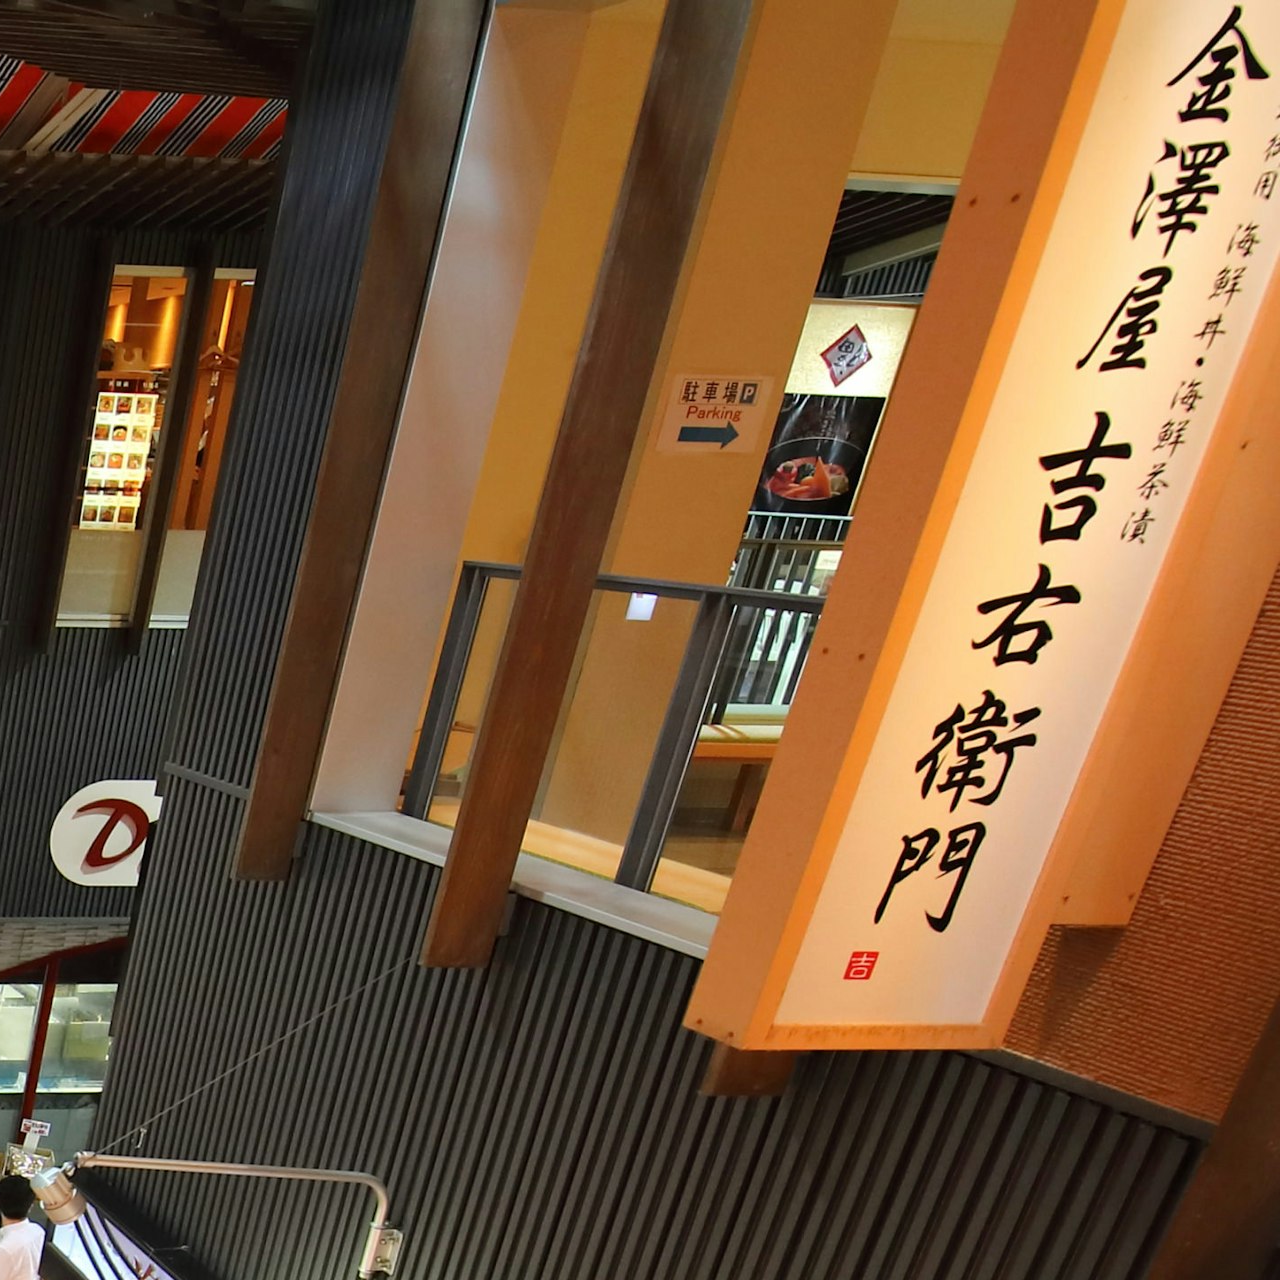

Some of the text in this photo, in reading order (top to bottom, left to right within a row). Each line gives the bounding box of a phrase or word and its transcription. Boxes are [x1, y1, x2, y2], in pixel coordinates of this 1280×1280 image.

[681, 380, 738, 405] 駐車場
[686, 405, 743, 423] Parking
